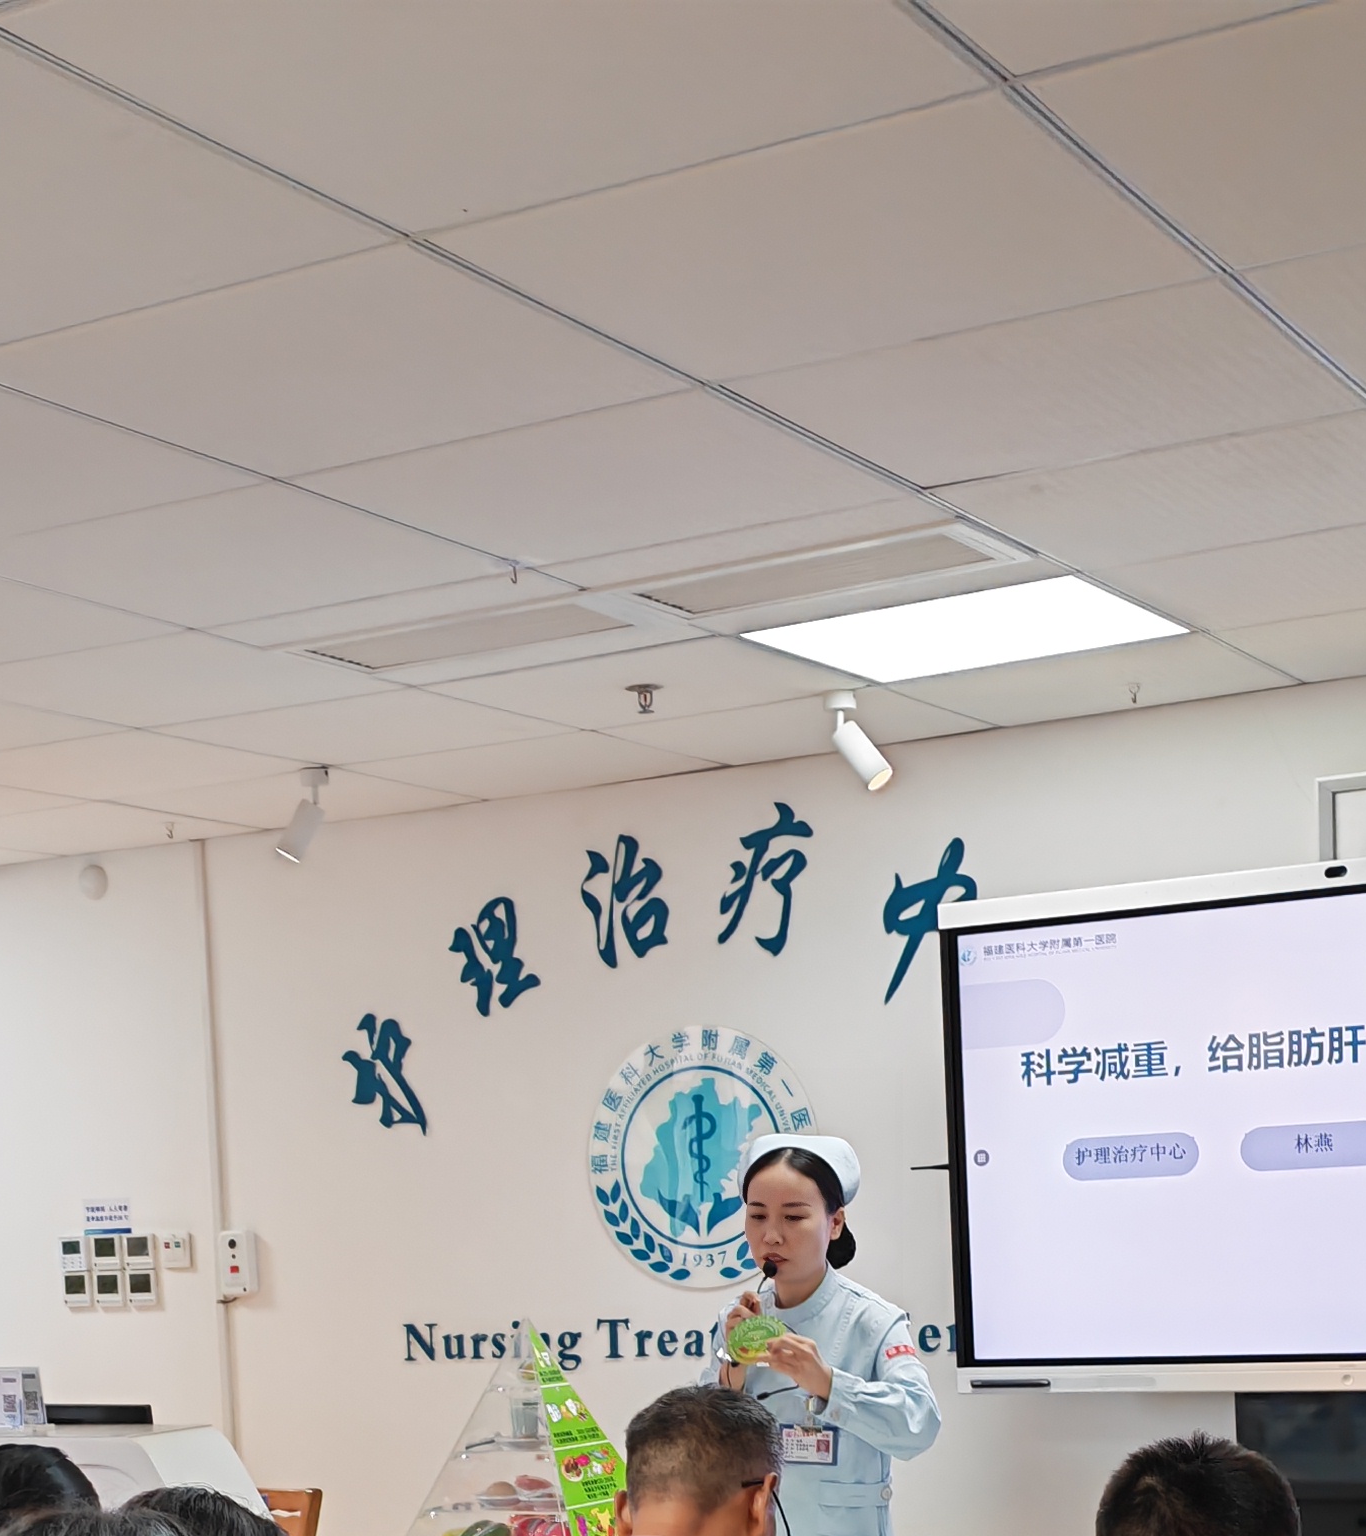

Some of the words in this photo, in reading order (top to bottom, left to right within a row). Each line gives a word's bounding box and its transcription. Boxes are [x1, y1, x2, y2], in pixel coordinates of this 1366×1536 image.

[983, 933, 1117, 957] 福建医科大学附属第一医院
[1075, 1142, 1186, 1167] 护理治疗中心
[1295, 1132, 1334, 1154] 林燕
[681, 1252, 727, 1268] 1937
